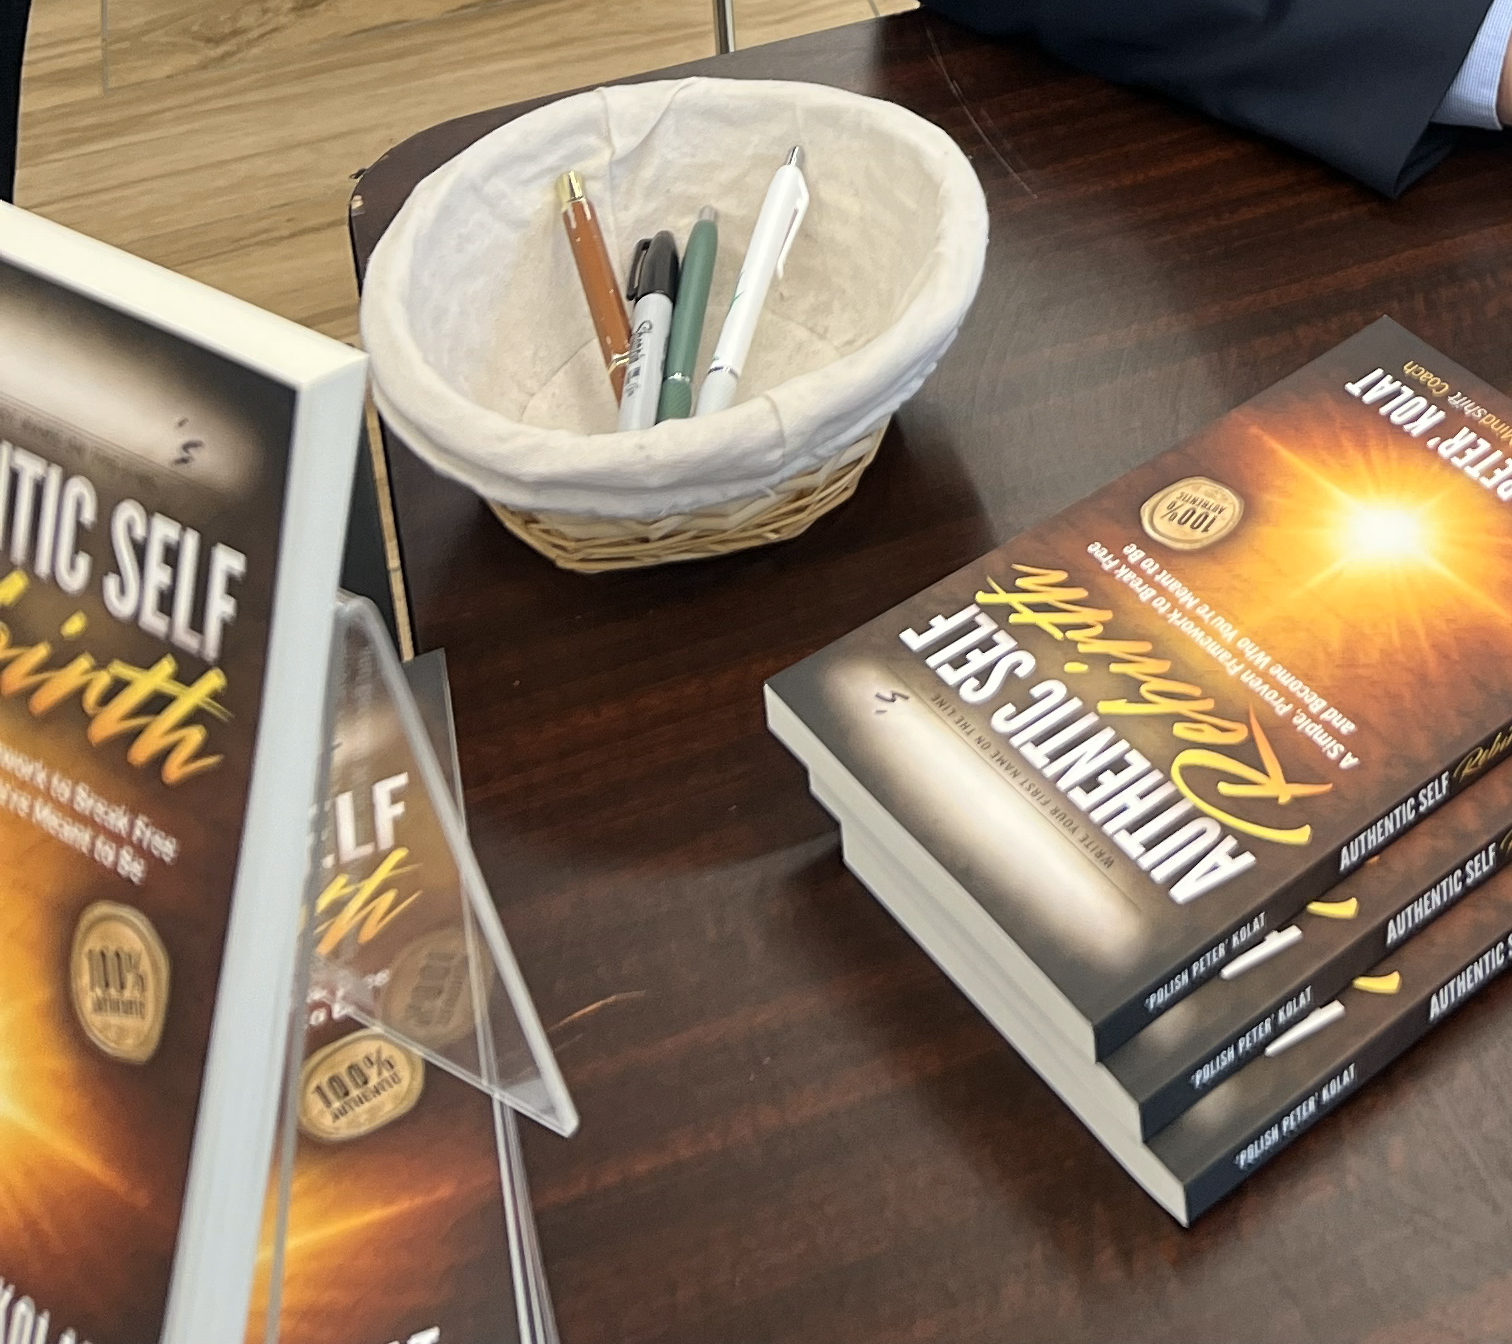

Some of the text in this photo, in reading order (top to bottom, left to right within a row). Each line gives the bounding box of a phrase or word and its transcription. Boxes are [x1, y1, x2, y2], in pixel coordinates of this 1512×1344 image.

[1343, 367, 1448, 436] KOLAT
[1402, 359, 1449, 397] Coach
[1166, 497, 1218, 534] 100%
[103, 498, 248, 664] SELF
[1086, 540, 1293, 717] Proven Framework Break Free
[1153, 566, 1328, 714] Become Who You're Meant
[975, 563, 1334, 846] Rebirth
[898, 602, 1257, 906] AUTHENTIC SELF
[1339, 799, 1419, 872] AUTHENTIC
[1386, 872, 1465, 946] AUTHENTIC
[1428, 944, 1508, 1022] AUTHENTIC
[311, 1043, 399, 1110] 100%
